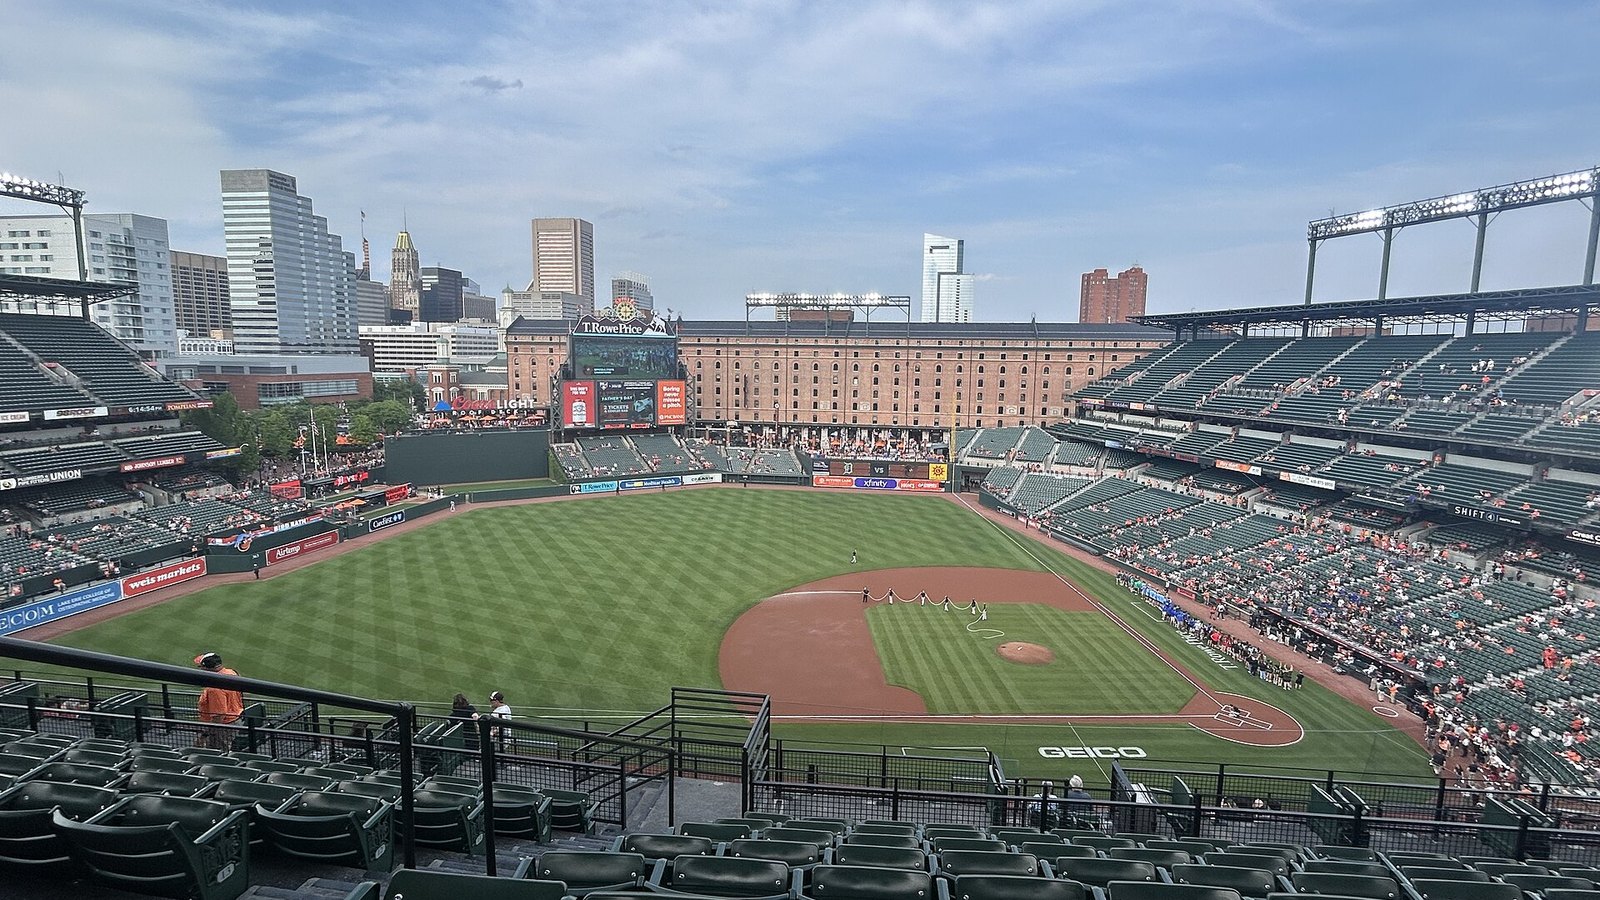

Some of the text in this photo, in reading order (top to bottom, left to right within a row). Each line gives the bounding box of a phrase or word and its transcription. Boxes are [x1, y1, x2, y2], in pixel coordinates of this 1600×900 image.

[167, 403, 197, 411] POMPEIAN
[496, 400, 534, 409] LIGHT
[50, 469, 81, 480] UNION
[864, 478, 888, 487] xfinity
[1455, 506, 1485, 519] SHIFT
[291, 518, 307, 527] BATH
[1572, 530, 1594, 540] Great
[275, 545, 300, 559] Airtemp
[129, 563, 201, 590] weis markets
[57, 599, 70, 607] LAKE
[83, 590, 103, 600] COLLEGE
[1038, 746, 1147, 759] GEICO
